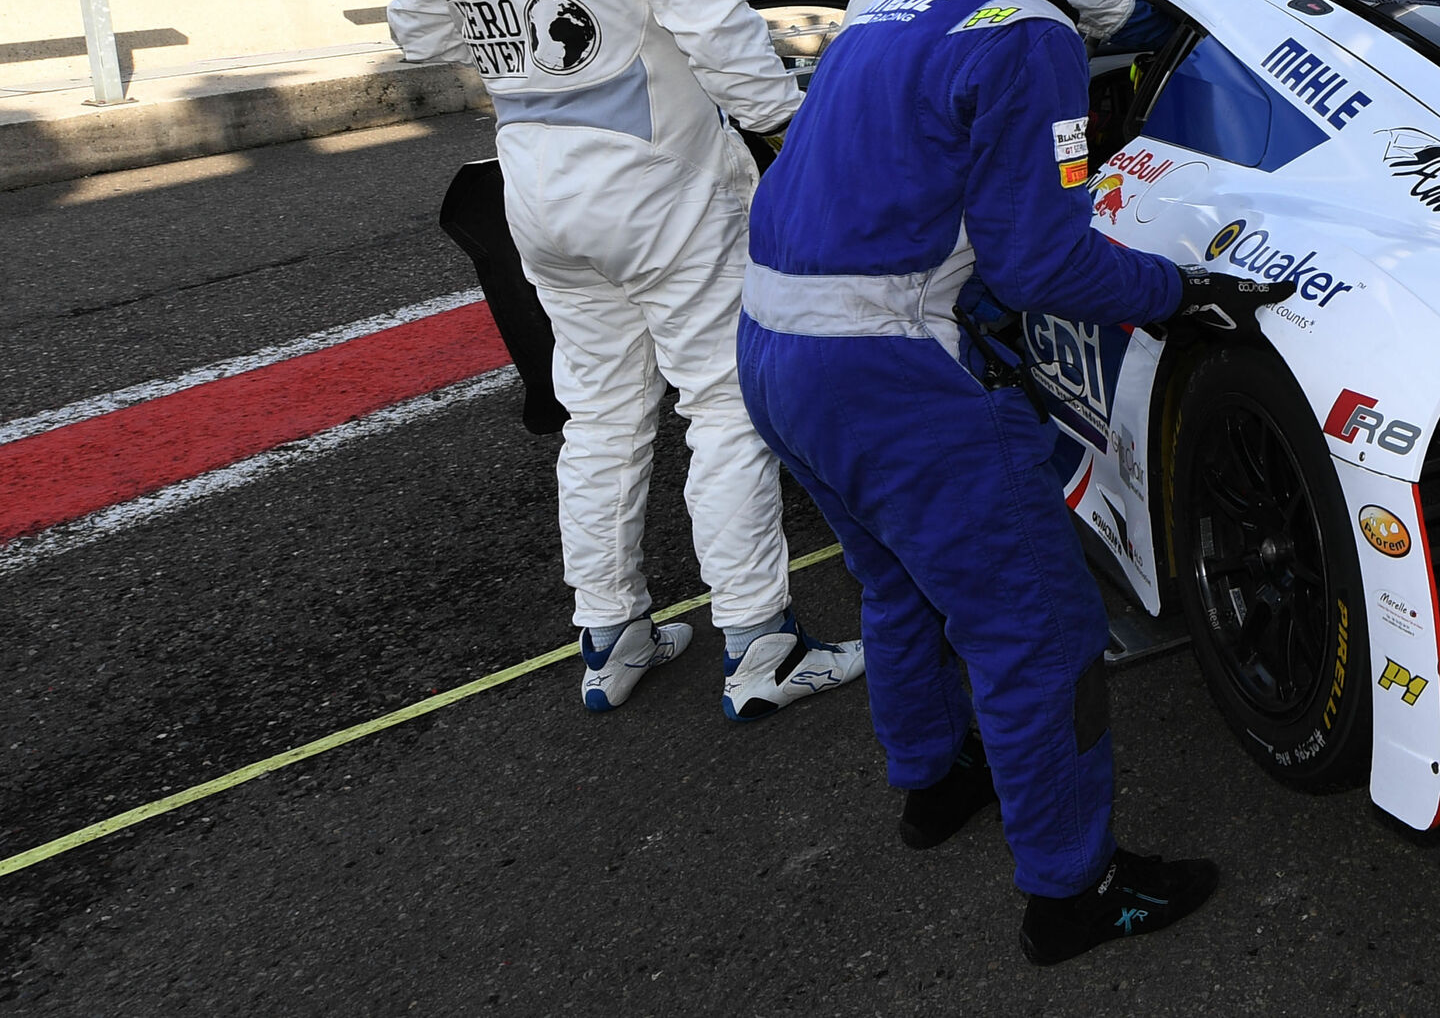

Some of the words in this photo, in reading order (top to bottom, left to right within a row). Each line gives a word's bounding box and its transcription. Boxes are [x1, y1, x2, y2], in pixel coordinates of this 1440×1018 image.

[962, 6, 1022, 29] P1
[466, 40, 527, 75] EVEN
[1260, 37, 1373, 132] MAHLE
[1229, 229, 1354, 309] Quaker
[1342, 404, 1422, 456] R8
[1364, 521, 1406, 552] Prorem
[1207, 608, 1222, 632] Rear
[1379, 592, 1408, 614] Marelle
[1322, 597, 1349, 730] PIRELLI
[1377, 655, 1430, 707] P1
